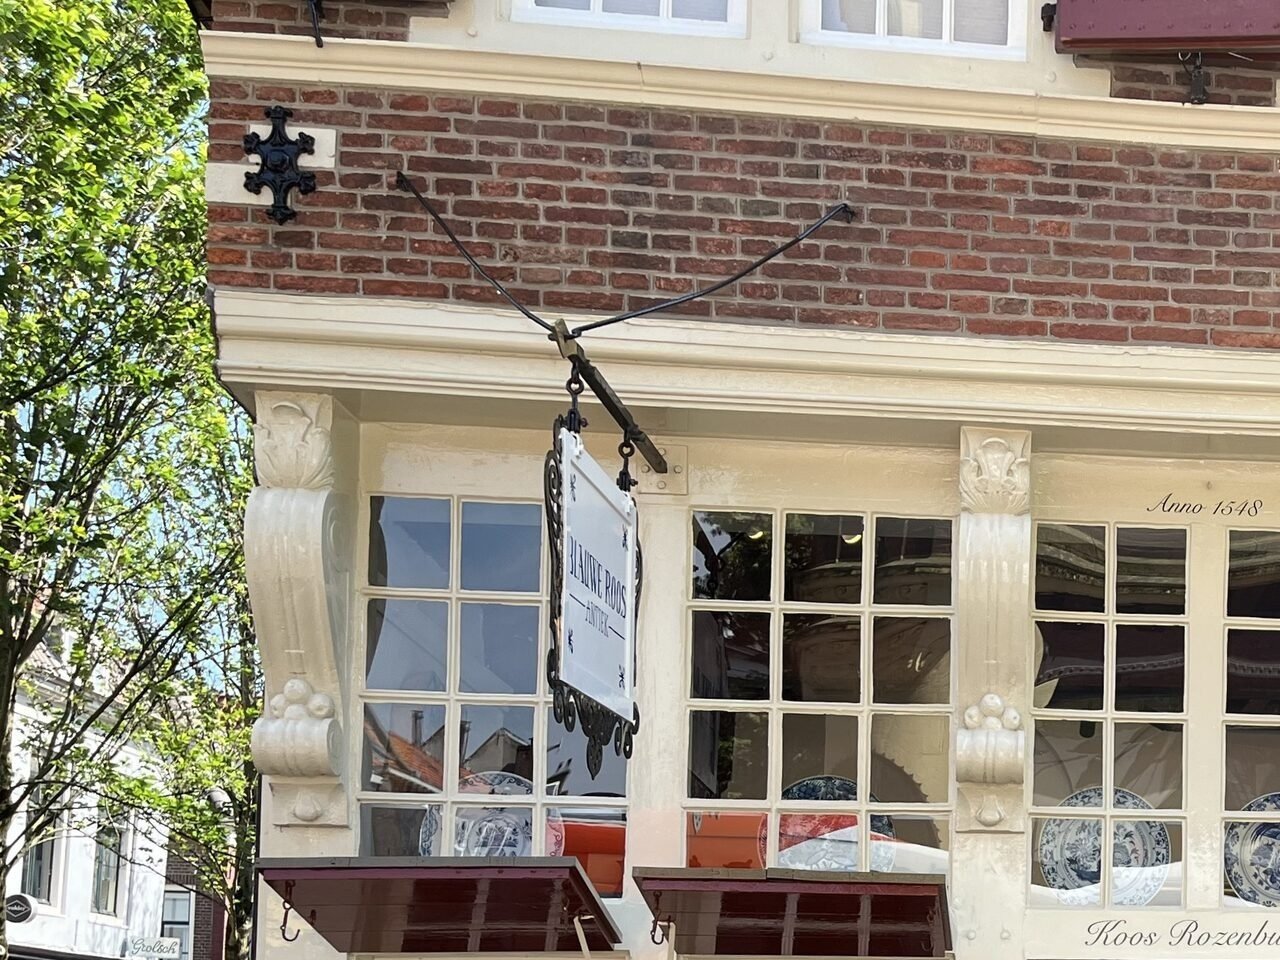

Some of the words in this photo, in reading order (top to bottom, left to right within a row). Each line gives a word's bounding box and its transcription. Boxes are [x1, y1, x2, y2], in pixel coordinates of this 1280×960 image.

[1146, 492, 1206, 515] Anno
[1212, 499, 1264, 517] 1548
[604, 568, 628, 619] ROOS
[1084, 919, 1161, 946] Koos
[131, 938, 178, 955] Grolsch
